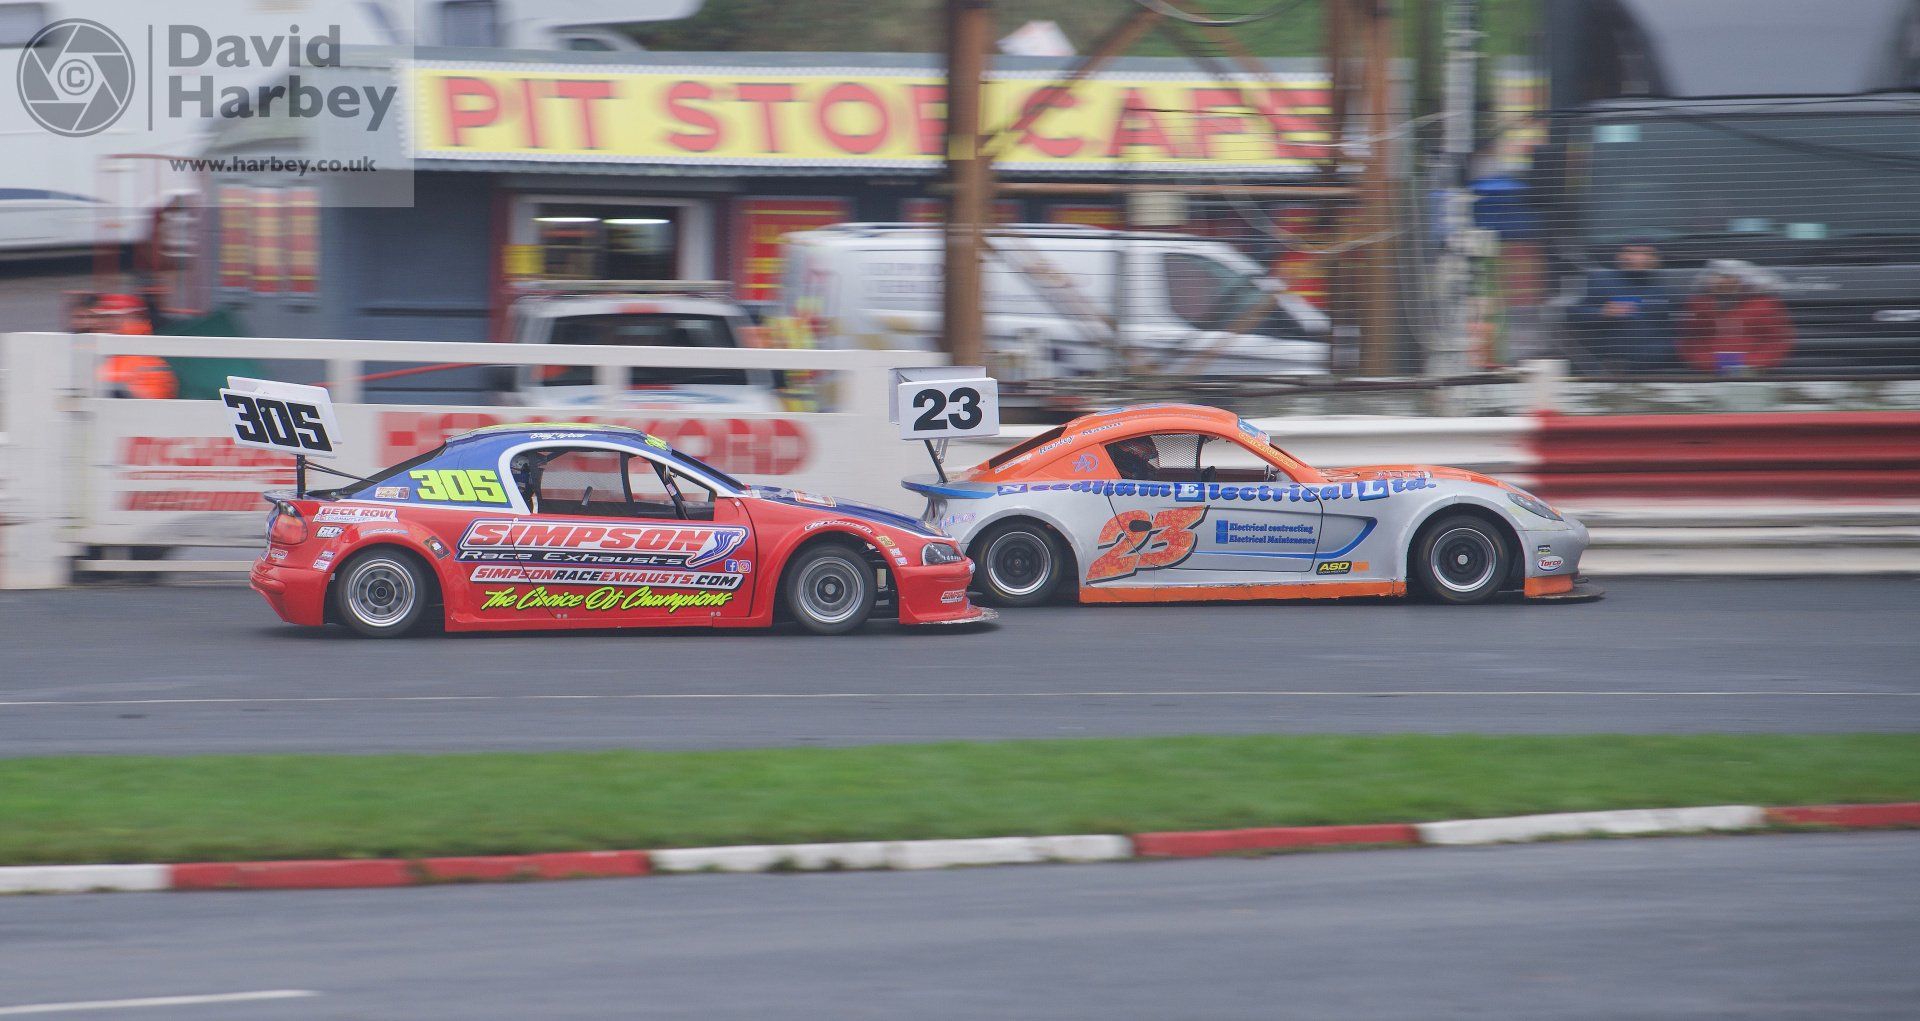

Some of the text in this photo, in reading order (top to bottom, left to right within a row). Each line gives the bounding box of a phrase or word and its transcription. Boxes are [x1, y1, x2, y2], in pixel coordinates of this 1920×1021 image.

[442, 76, 614, 150] PIT
[1012, 86, 1333, 159] CAFE
[913, 386, 983, 431] 23
[223, 393, 333, 451] 305
[409, 469, 508, 503] 305
[997, 477, 1437, 502] Needham Electrical Ltd.
[360, 508, 394, 519] ROW
[466, 524, 713, 552] SIMPSON
[1229, 523, 1313, 534] Electrical contracting
[1229, 535, 1266, 544] Electrical
[460, 551, 683, 565] Race Exhausts
[1086, 505, 1211, 585] 23
[475, 568, 738, 587] SIMPSONRACEEXHAUSTS.COM
[1319, 562, 1350, 571] ASD
[481, 586, 732, 613] The Choice Of Champions
